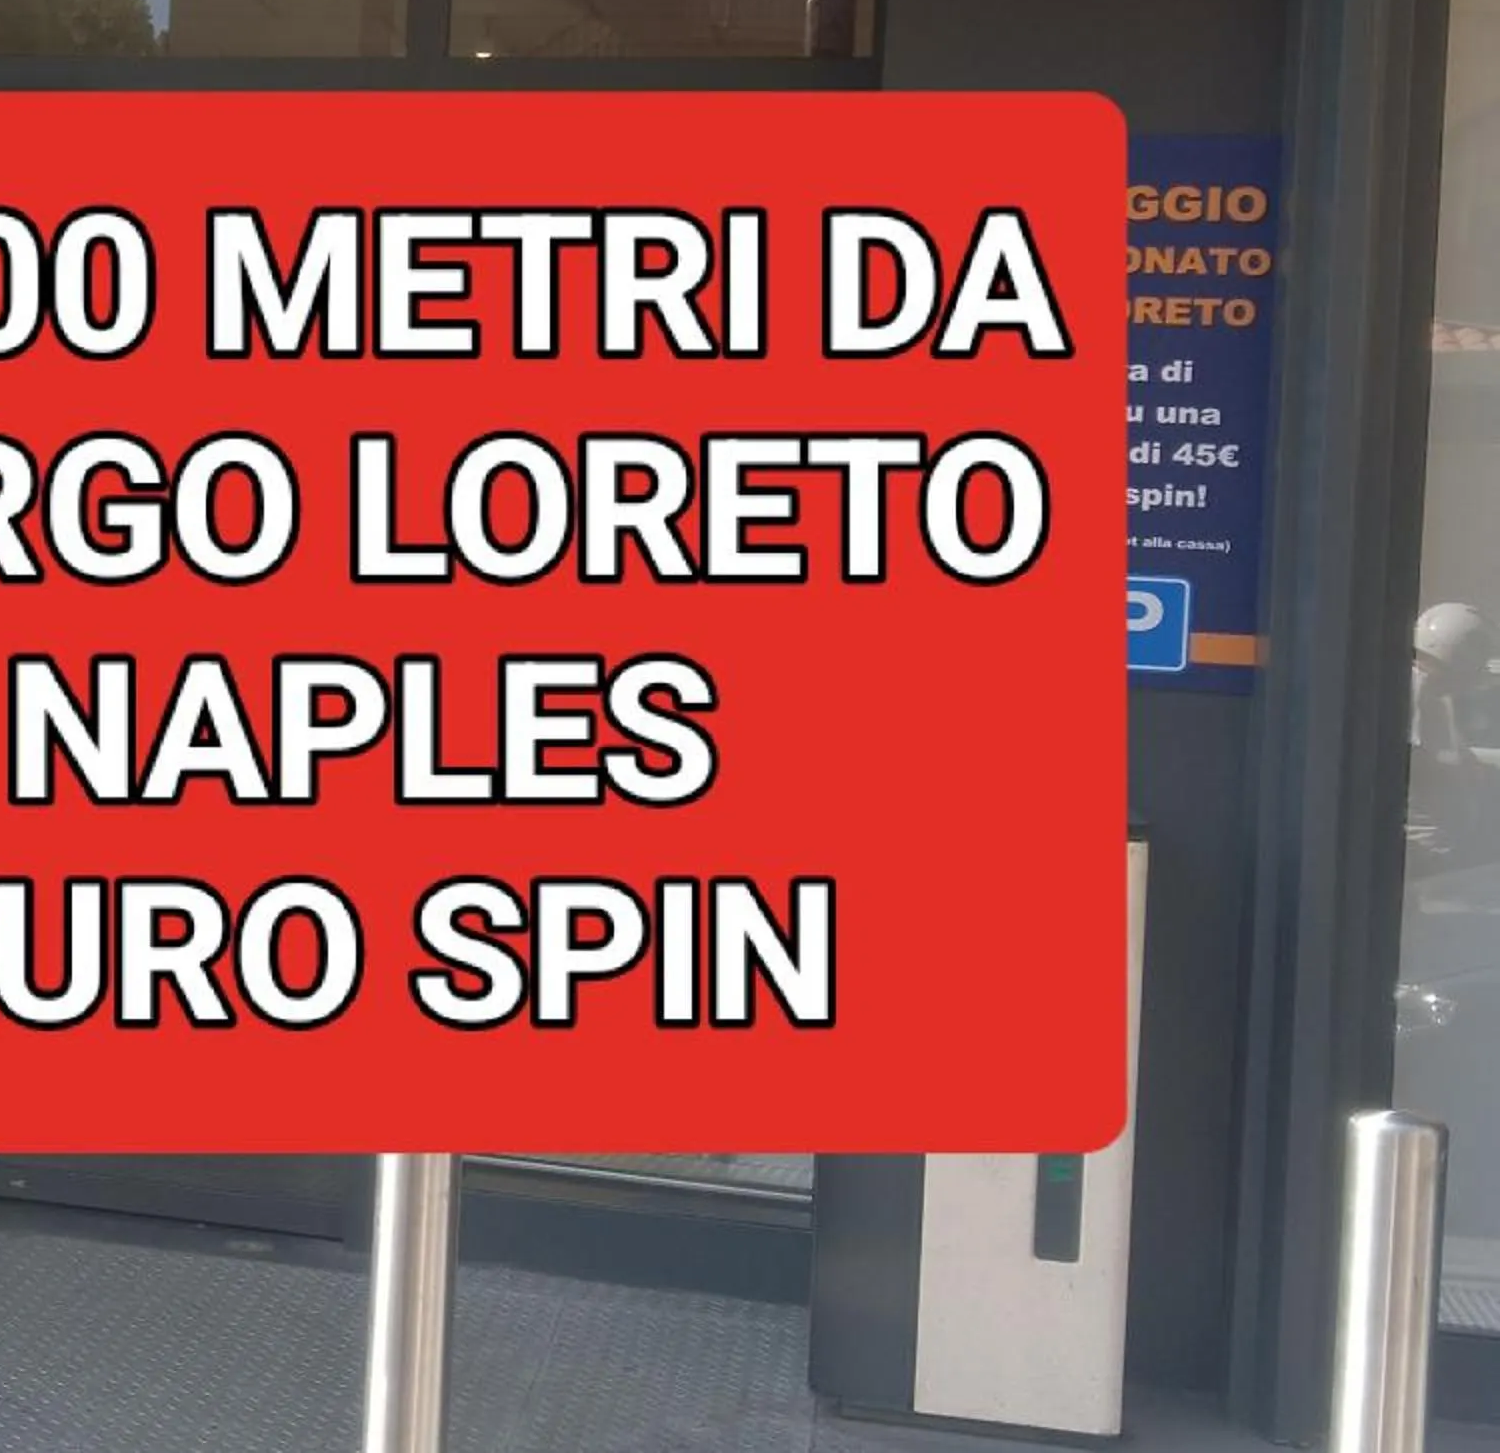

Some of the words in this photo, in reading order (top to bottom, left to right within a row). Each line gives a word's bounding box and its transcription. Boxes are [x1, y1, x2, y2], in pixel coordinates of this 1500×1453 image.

[1127, 296, 1256, 327] RETO
[1161, 360, 1193, 383] di
[1157, 406, 1221, 426] una
[1129, 442, 1161, 465] di
[1172, 443, 1240, 468] 45€
[1143, 537, 1172, 548] alla
[1177, 540, 1231, 554] cassa)
